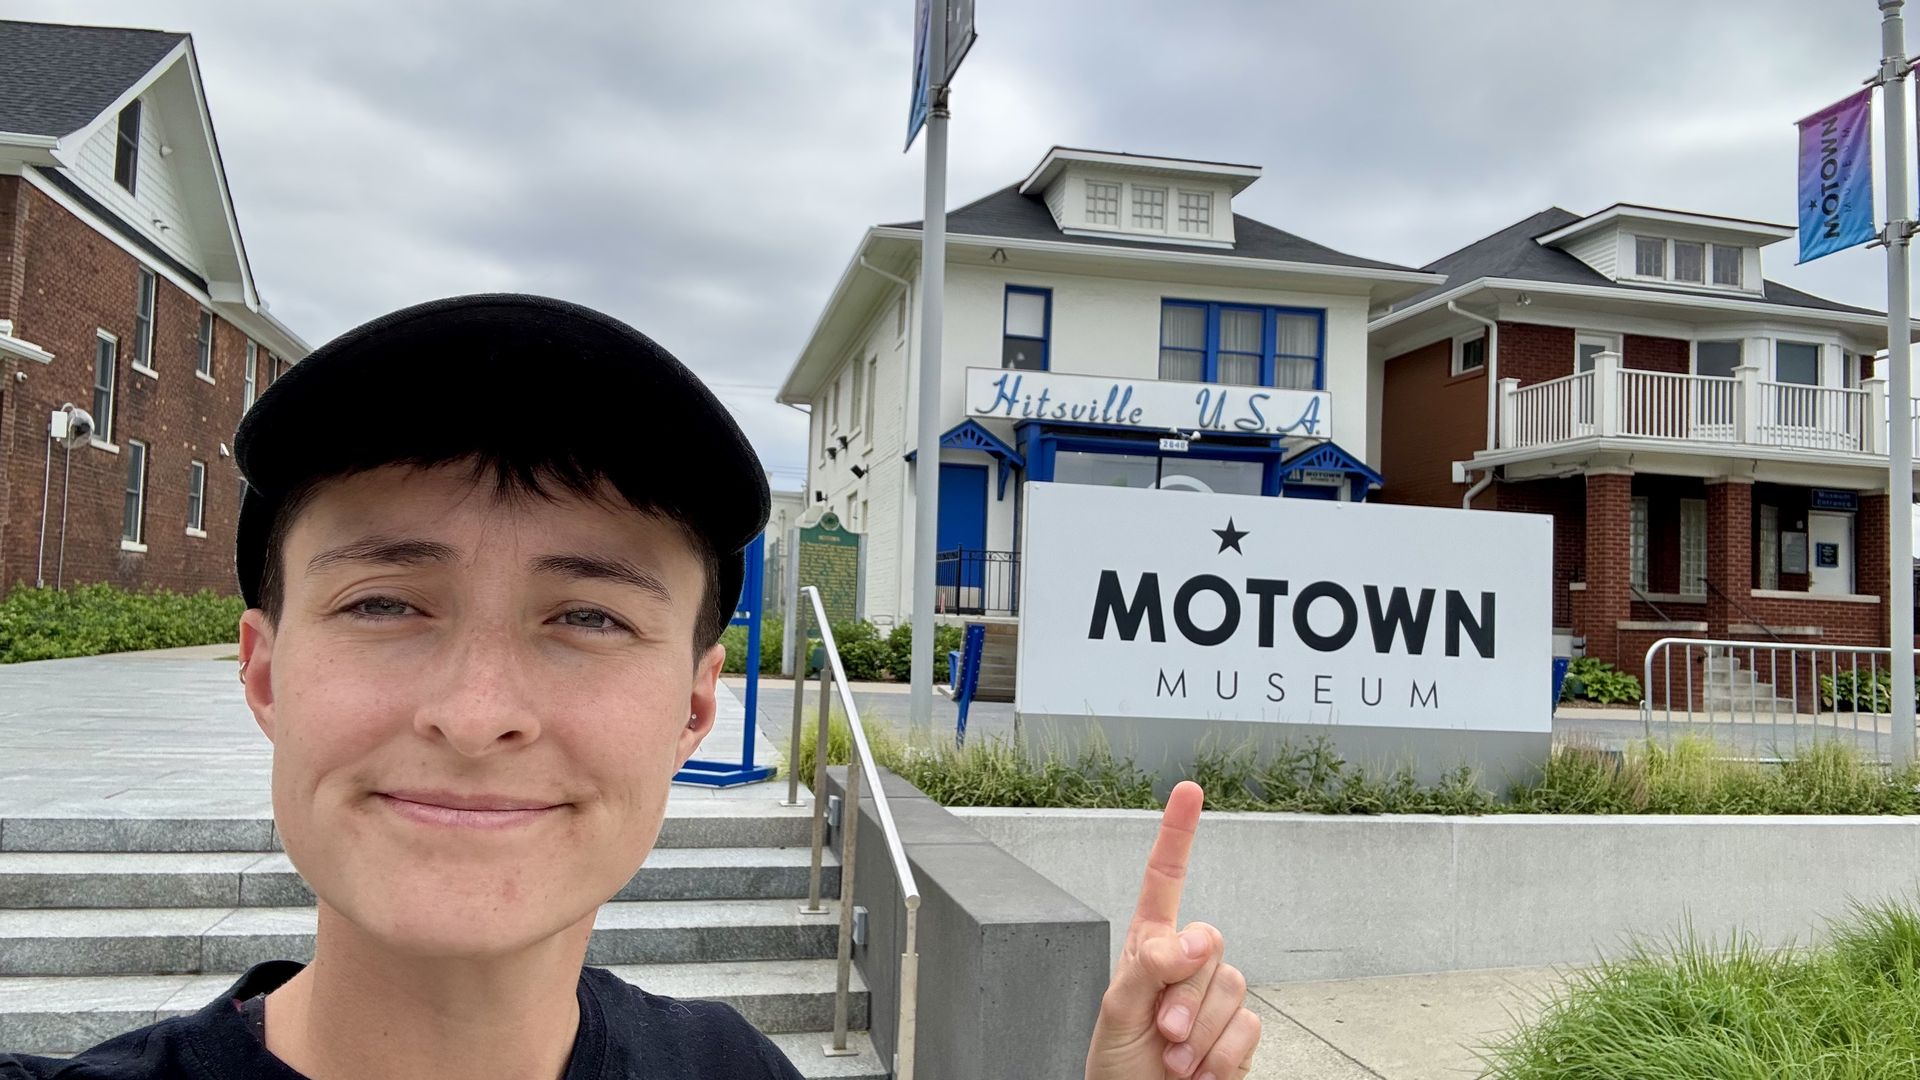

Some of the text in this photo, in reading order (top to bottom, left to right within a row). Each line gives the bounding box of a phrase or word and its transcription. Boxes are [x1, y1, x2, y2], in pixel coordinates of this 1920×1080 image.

[1820, 116, 1840, 240] MOTOWN
[975, 373, 1143, 424] Hitsville
[1087, 569, 1496, 659] MOTOWN
[1156, 668, 1440, 710] MUSEUM
